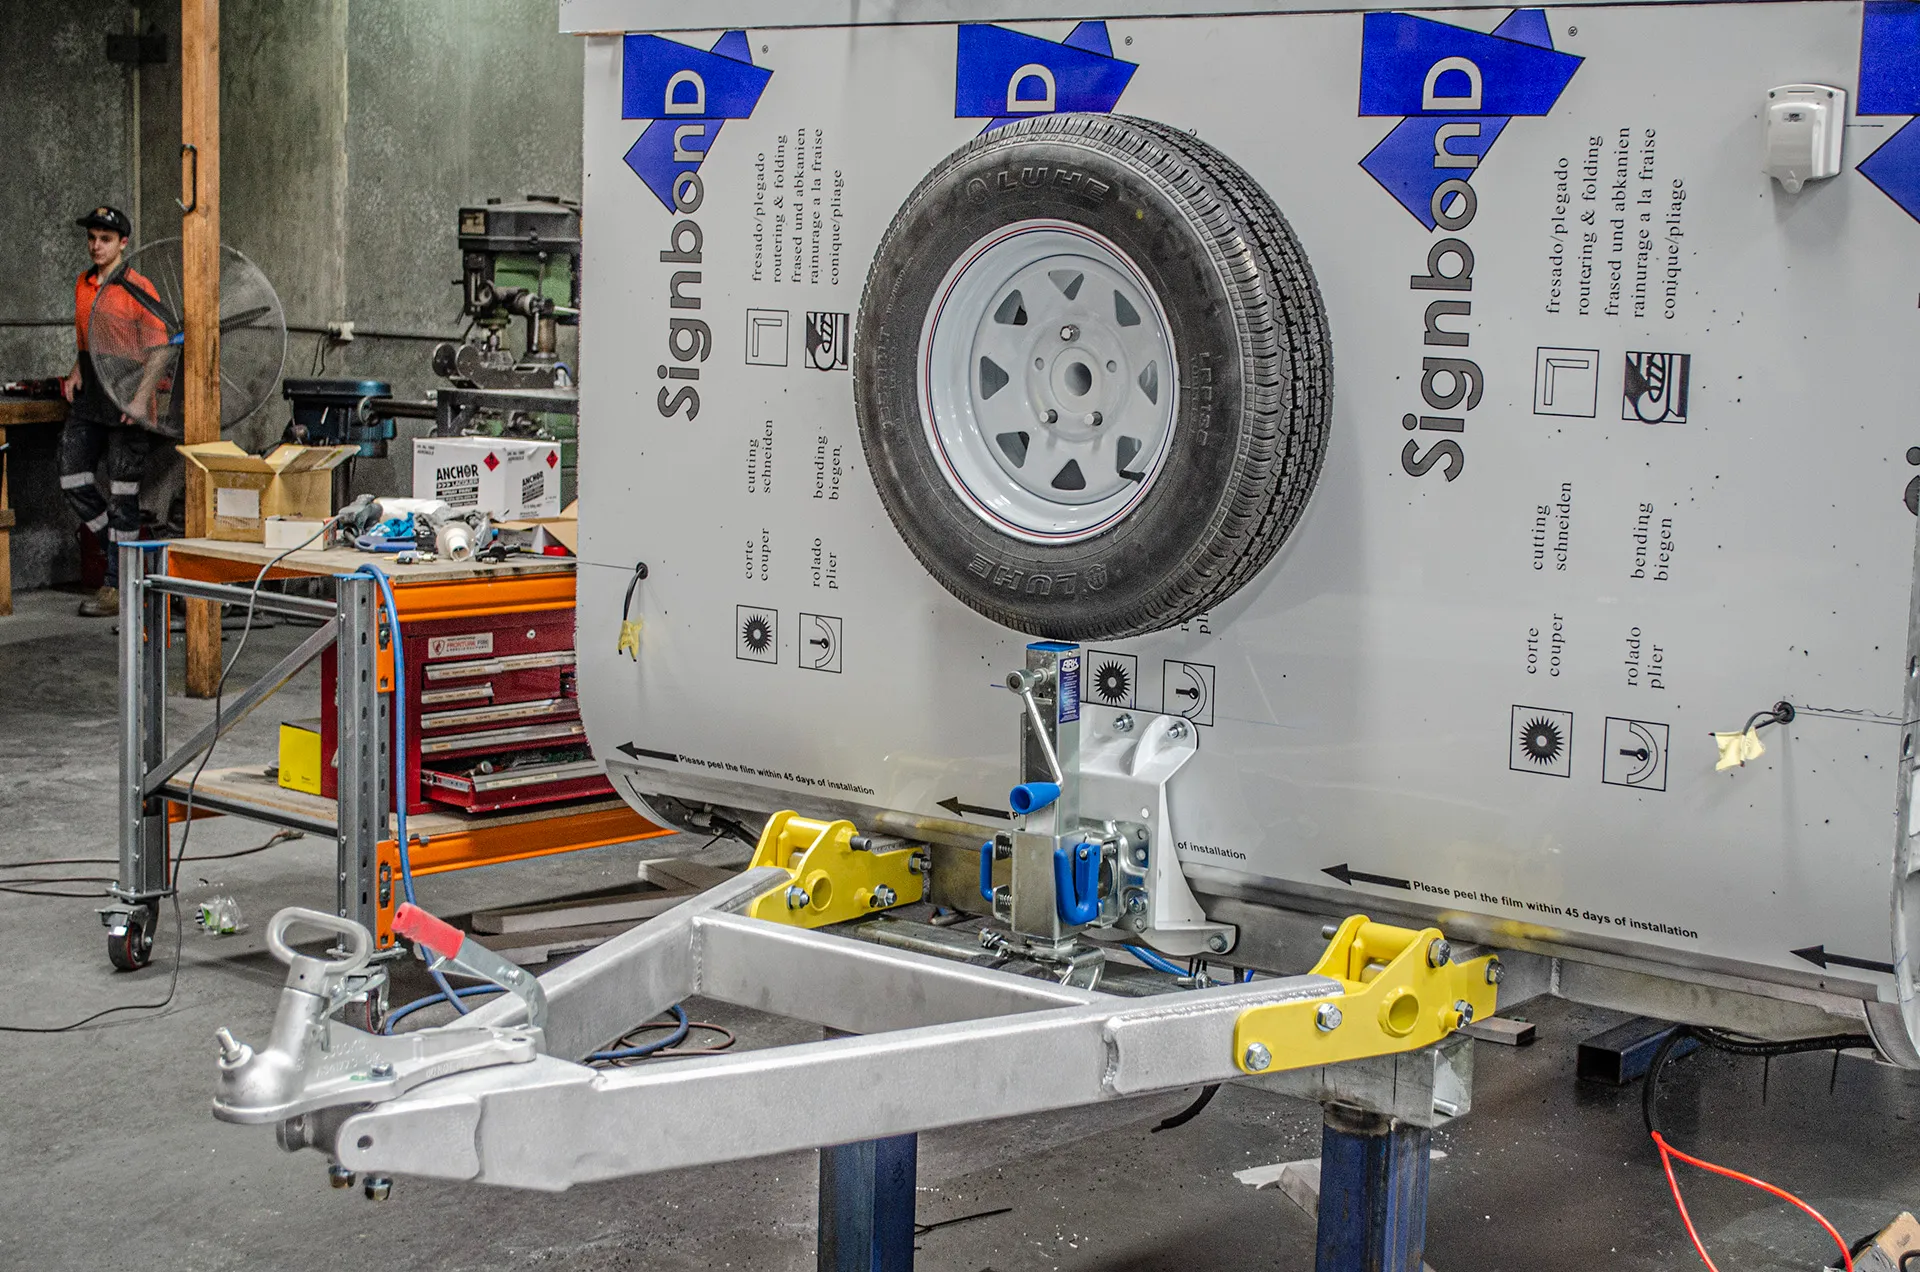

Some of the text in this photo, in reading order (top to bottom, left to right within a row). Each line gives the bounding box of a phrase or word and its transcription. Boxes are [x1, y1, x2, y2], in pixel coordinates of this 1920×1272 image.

[810, 128, 823, 173] fraise
[1637, 128, 1657, 181] fraise
[773, 134, 788, 283] routering & folding
[790, 127, 807, 284] frased und abkanien
[810, 177, 823, 192] la
[995, 166, 1111, 203] LUHE
[1636, 188, 1653, 205] la
[751, 152, 767, 282] fresado/plegado
[828, 169, 845, 286] conique/pliage
[1545, 157, 1571, 314] fresado/plegado
[1577, 135, 1604, 316] routering & folding
[1603, 127, 1631, 317] frased und abkanien
[809, 210, 824, 285] rainurage
[1633, 229, 1653, 319] rainurage
[1663, 178, 1687, 320] conique/pliage
[436, 464, 480, 482] ANCHOR
[521, 470, 545, 486] ANCHOR
[745, 438, 760, 494] cutting
[761, 419, 773, 494] schneiden
[812, 435, 829, 499] bending
[828, 447, 843, 501] biegen
[760, 527, 772, 582] couper
[1530, 504, 1551, 571] cutting
[1553, 482, 1572, 572] schneiden
[1629, 502, 1654, 579] bending
[1653, 518, 1675, 582] biegen
[744, 540, 754, 580] corte
[810, 537, 823, 588] rolado
[825, 551, 839, 590] plier
[967, 552, 1078, 597] LUHE
[1526, 627, 1540, 675] corte
[1549, 612, 1566, 678] couper
[1624, 626, 1642, 688] rolado
[1646, 644, 1666, 690] plier
[678, 753, 875, 796] Please peel the film within 45 days of installation
[1177, 840, 1247, 861] of installation
[1412, 880, 1699, 940] Please peel the film within 45 days of installation
